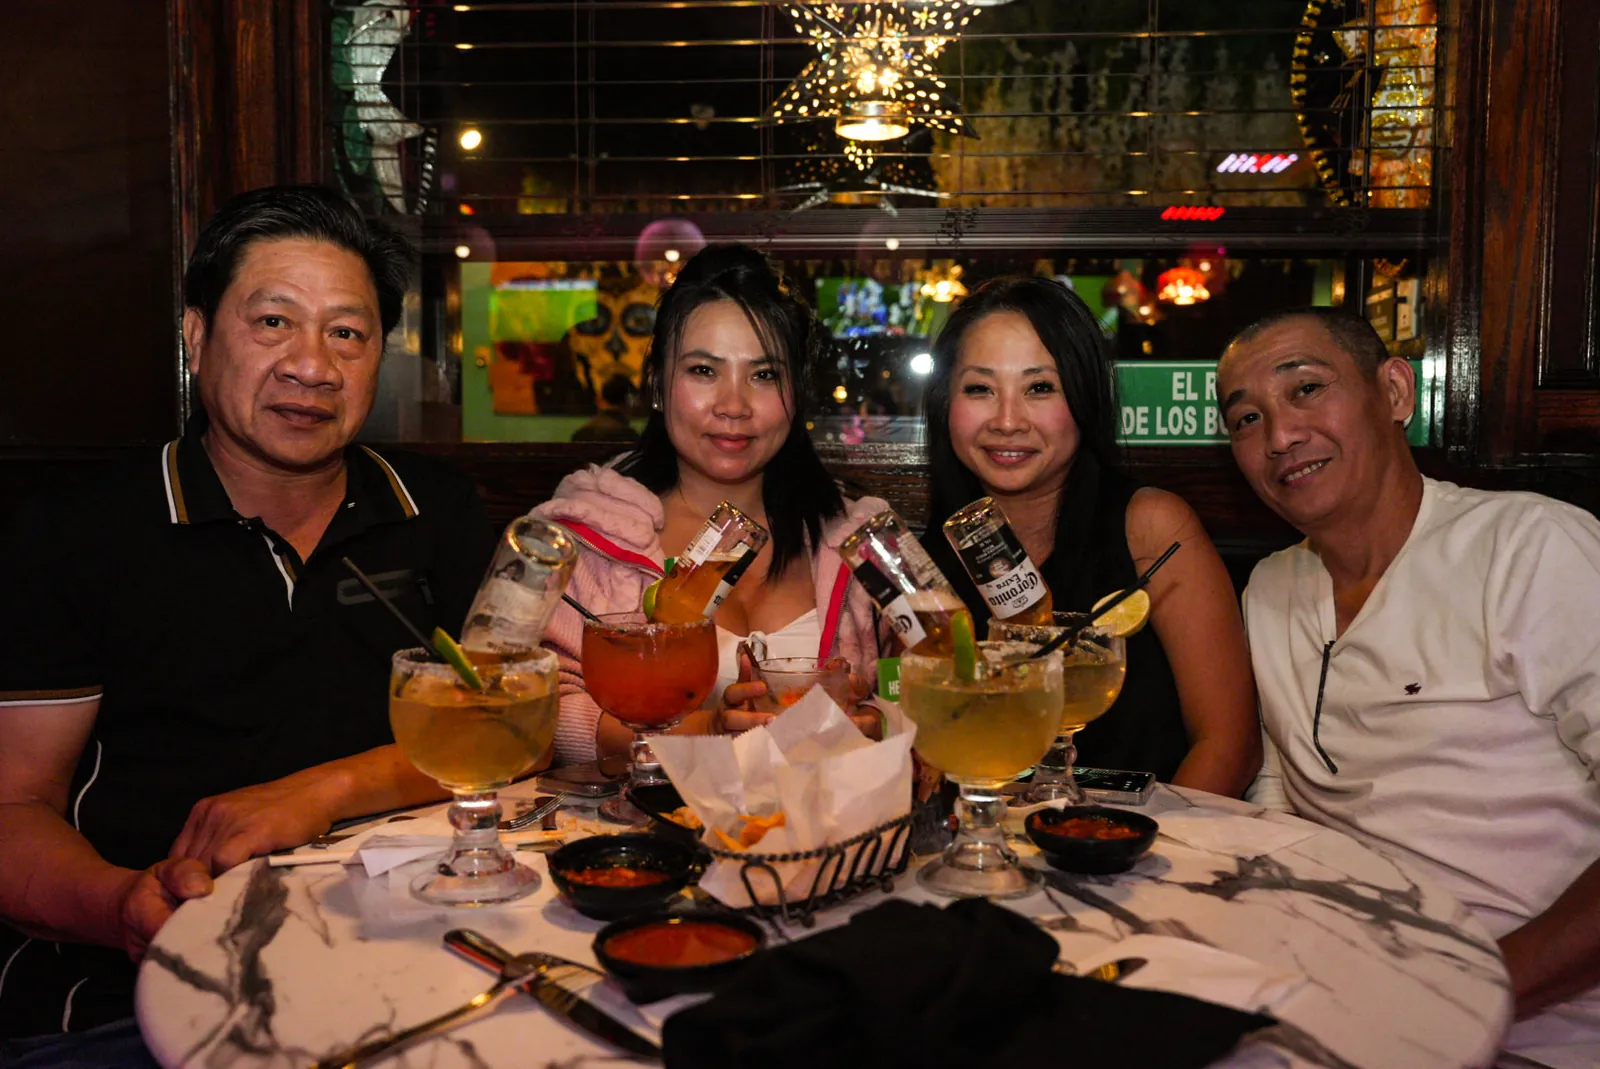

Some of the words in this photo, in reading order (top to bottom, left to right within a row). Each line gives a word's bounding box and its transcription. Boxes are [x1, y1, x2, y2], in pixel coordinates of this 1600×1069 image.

[1172, 371, 1198, 401] EL
[1121, 406, 1149, 436] DE
[1156, 406, 1198, 436] LOS
[988, 571, 1039, 607] Coronita
[996, 573, 1022, 590] Extra
